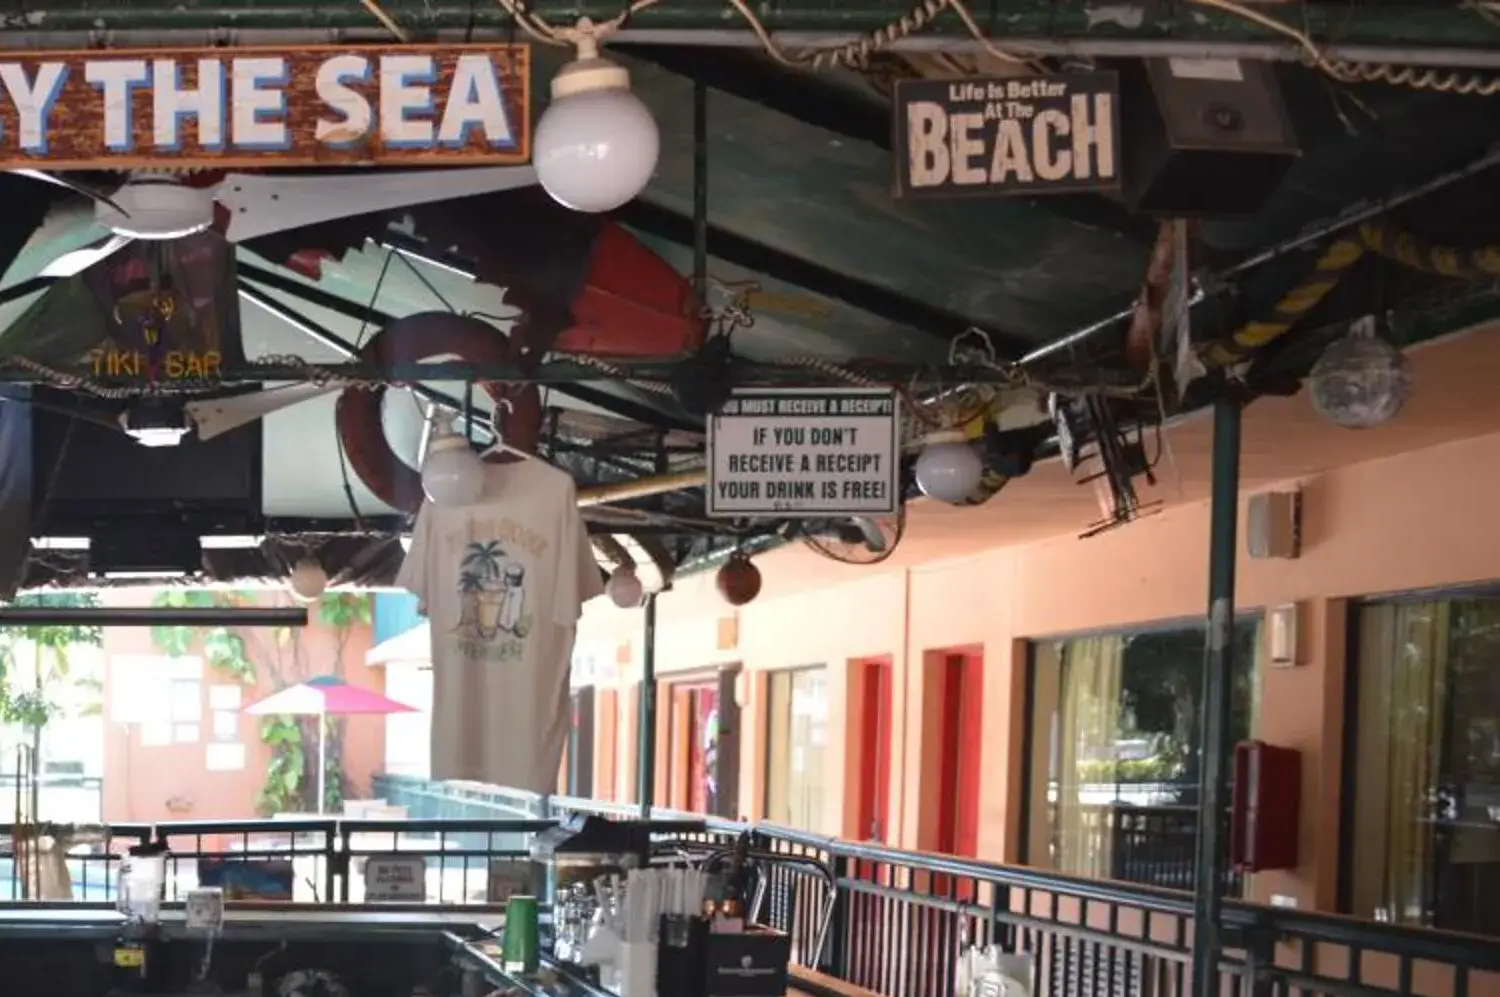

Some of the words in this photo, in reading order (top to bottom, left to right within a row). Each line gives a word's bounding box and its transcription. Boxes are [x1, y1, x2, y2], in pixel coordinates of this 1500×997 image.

[950, 85, 985, 101] Life
[1007, 80, 1067, 98] Better
[85, 56, 292, 153] THE
[314, 53, 515, 149] SEA
[984, 103, 1002, 120] At
[1006, 102, 1034, 118] The
[907, 92, 1113, 188] BEACH
[90, 350, 140, 376] TIKI
[166, 351, 221, 378] BAR
[741, 399, 776, 414] MUST
[778, 399, 827, 414] RECEIVE
[829, 399, 839, 414] A
[753, 427, 768, 445] IF
[773, 427, 805, 445] YOU
[811, 427, 859, 445] DON'T
[729, 454, 793, 473] RECEIVE
[801, 454, 810, 473] A
[816, 454, 881, 473] RECEIPT
[718, 481, 759, 499] YOUR
[766, 481, 814, 499] DRINK
[822, 481, 837, 499] IS
[843, 481, 886, 499] FREE!
